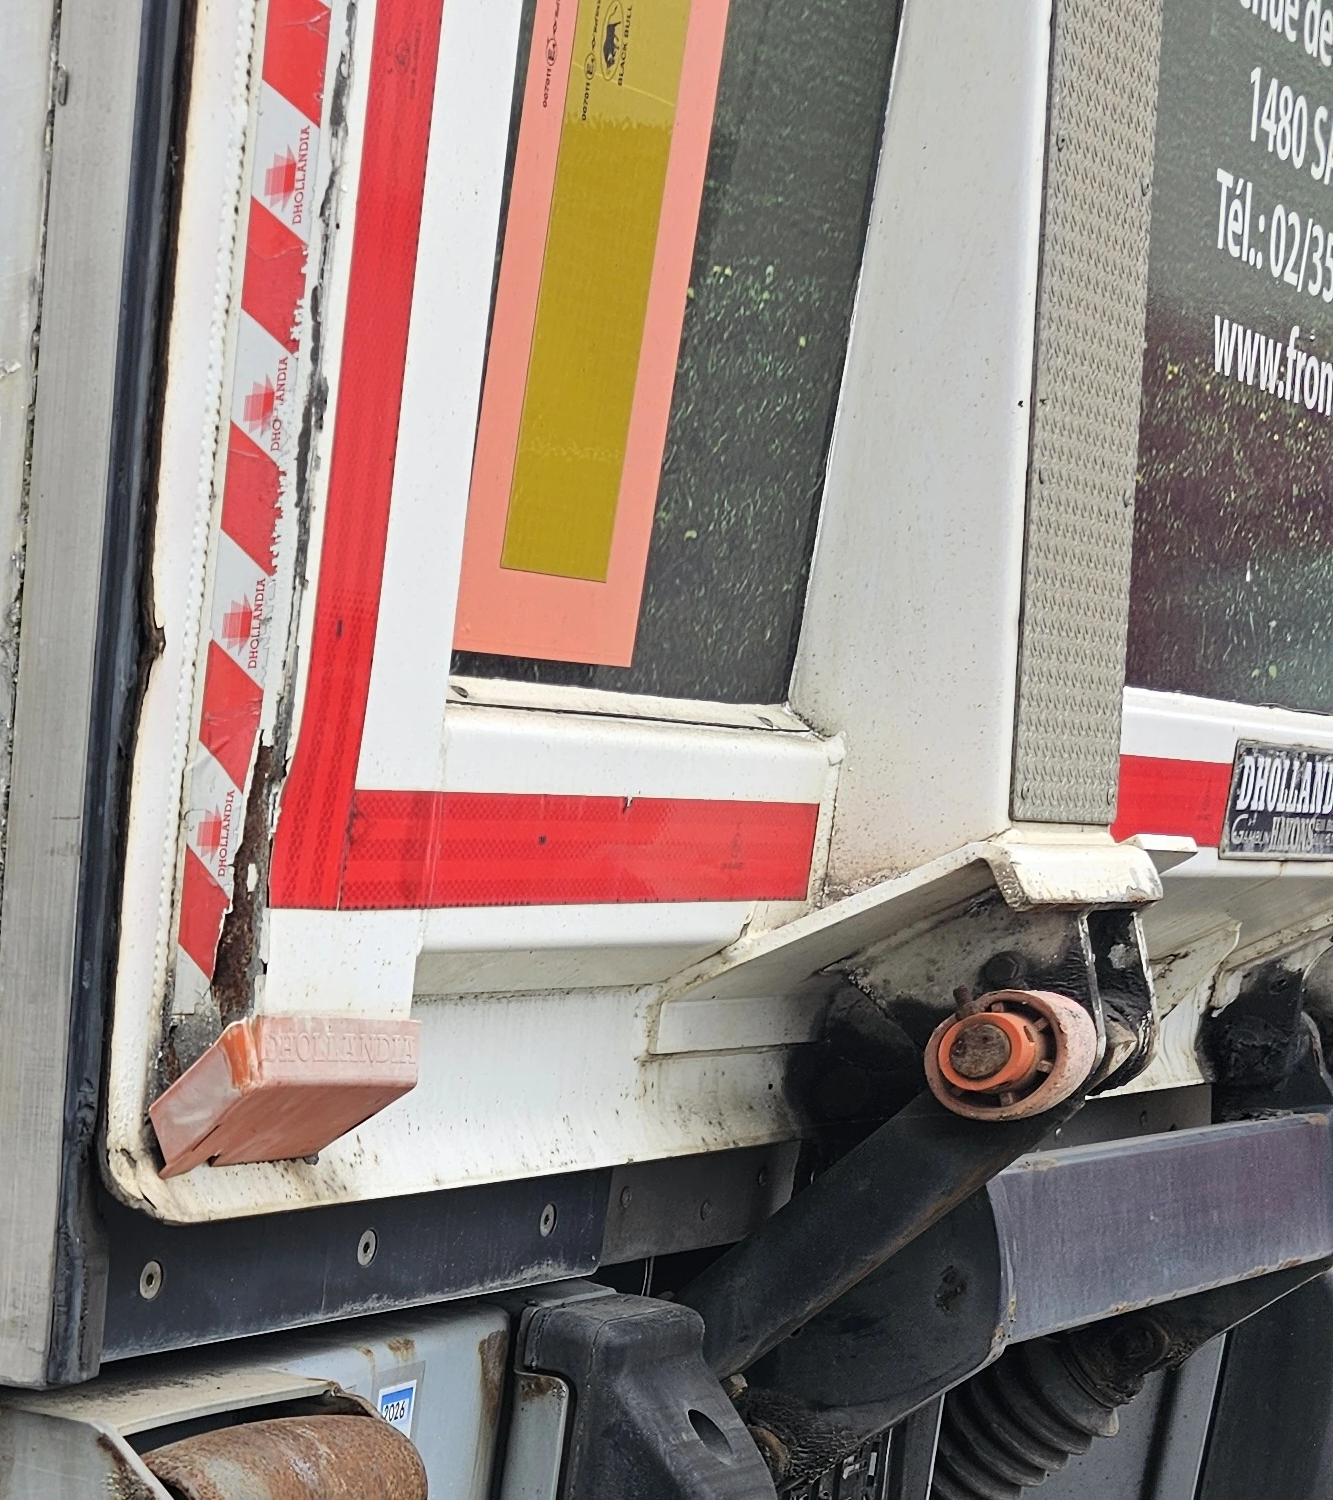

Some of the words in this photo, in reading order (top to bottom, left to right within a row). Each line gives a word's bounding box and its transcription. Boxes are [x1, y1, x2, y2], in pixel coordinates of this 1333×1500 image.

[617, 42, 628, 87] BLACK
[624, 5, 633, 38] BULL
[1250, 66, 1308, 170] 1480
[292, 125, 311, 225] DHOLLANDIA
[270, 356, 288, 452] DHOANDIA
[248, 577, 266, 669] DHOLLANDIA
[218, 789, 235, 877] DHOLLANDIA
[263, 1032, 417, 1065] DHOLLANDIA
[384, 1400, 406, 1422] 2026
